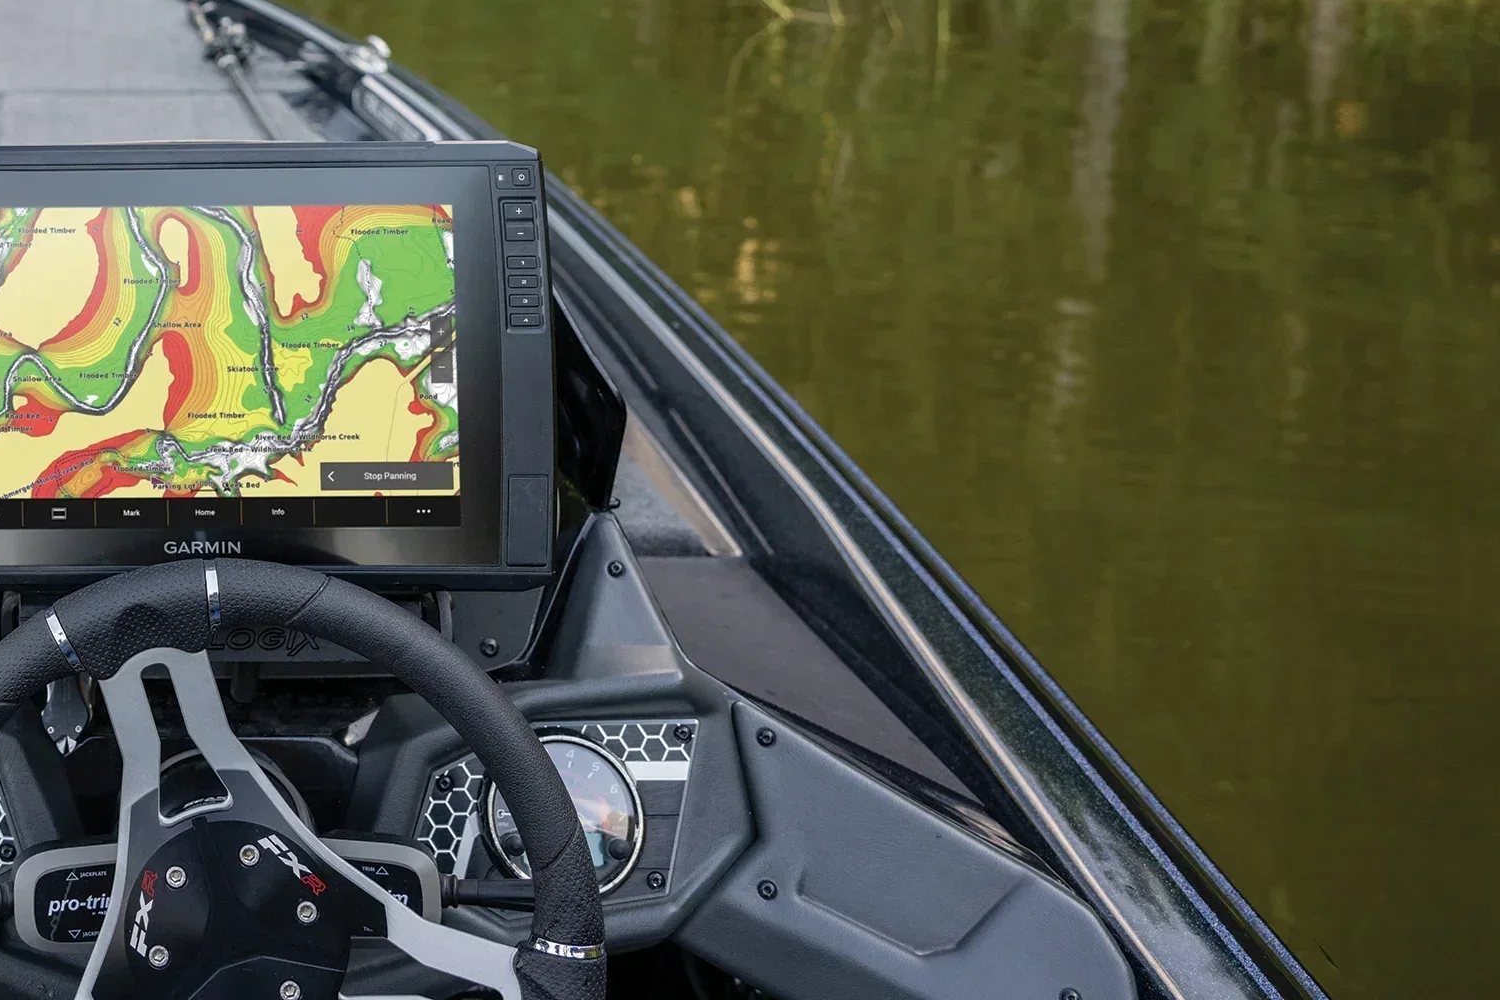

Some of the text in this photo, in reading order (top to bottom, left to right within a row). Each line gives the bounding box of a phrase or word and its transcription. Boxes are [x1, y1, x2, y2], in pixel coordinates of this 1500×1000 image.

[300, 312, 309, 321] 12
[113, 317, 122, 327] 12
[347, 324, 356, 332] 16
[57, 464, 78, 478] Creek
[79, 458, 94, 468] Bed
[363, 471, 417, 481] Stop Panning
[163, 541, 241, 554] GARMIN
[210, 627, 320, 656] LOGIX
[565, 750, 575, 758] 4
[591, 763, 601, 771] 5
[610, 785, 618, 793] 6
[257, 834, 328, 896] FXR
[47, 893, 111, 916] pro-tri
[129, 869, 159, 957] FXR
